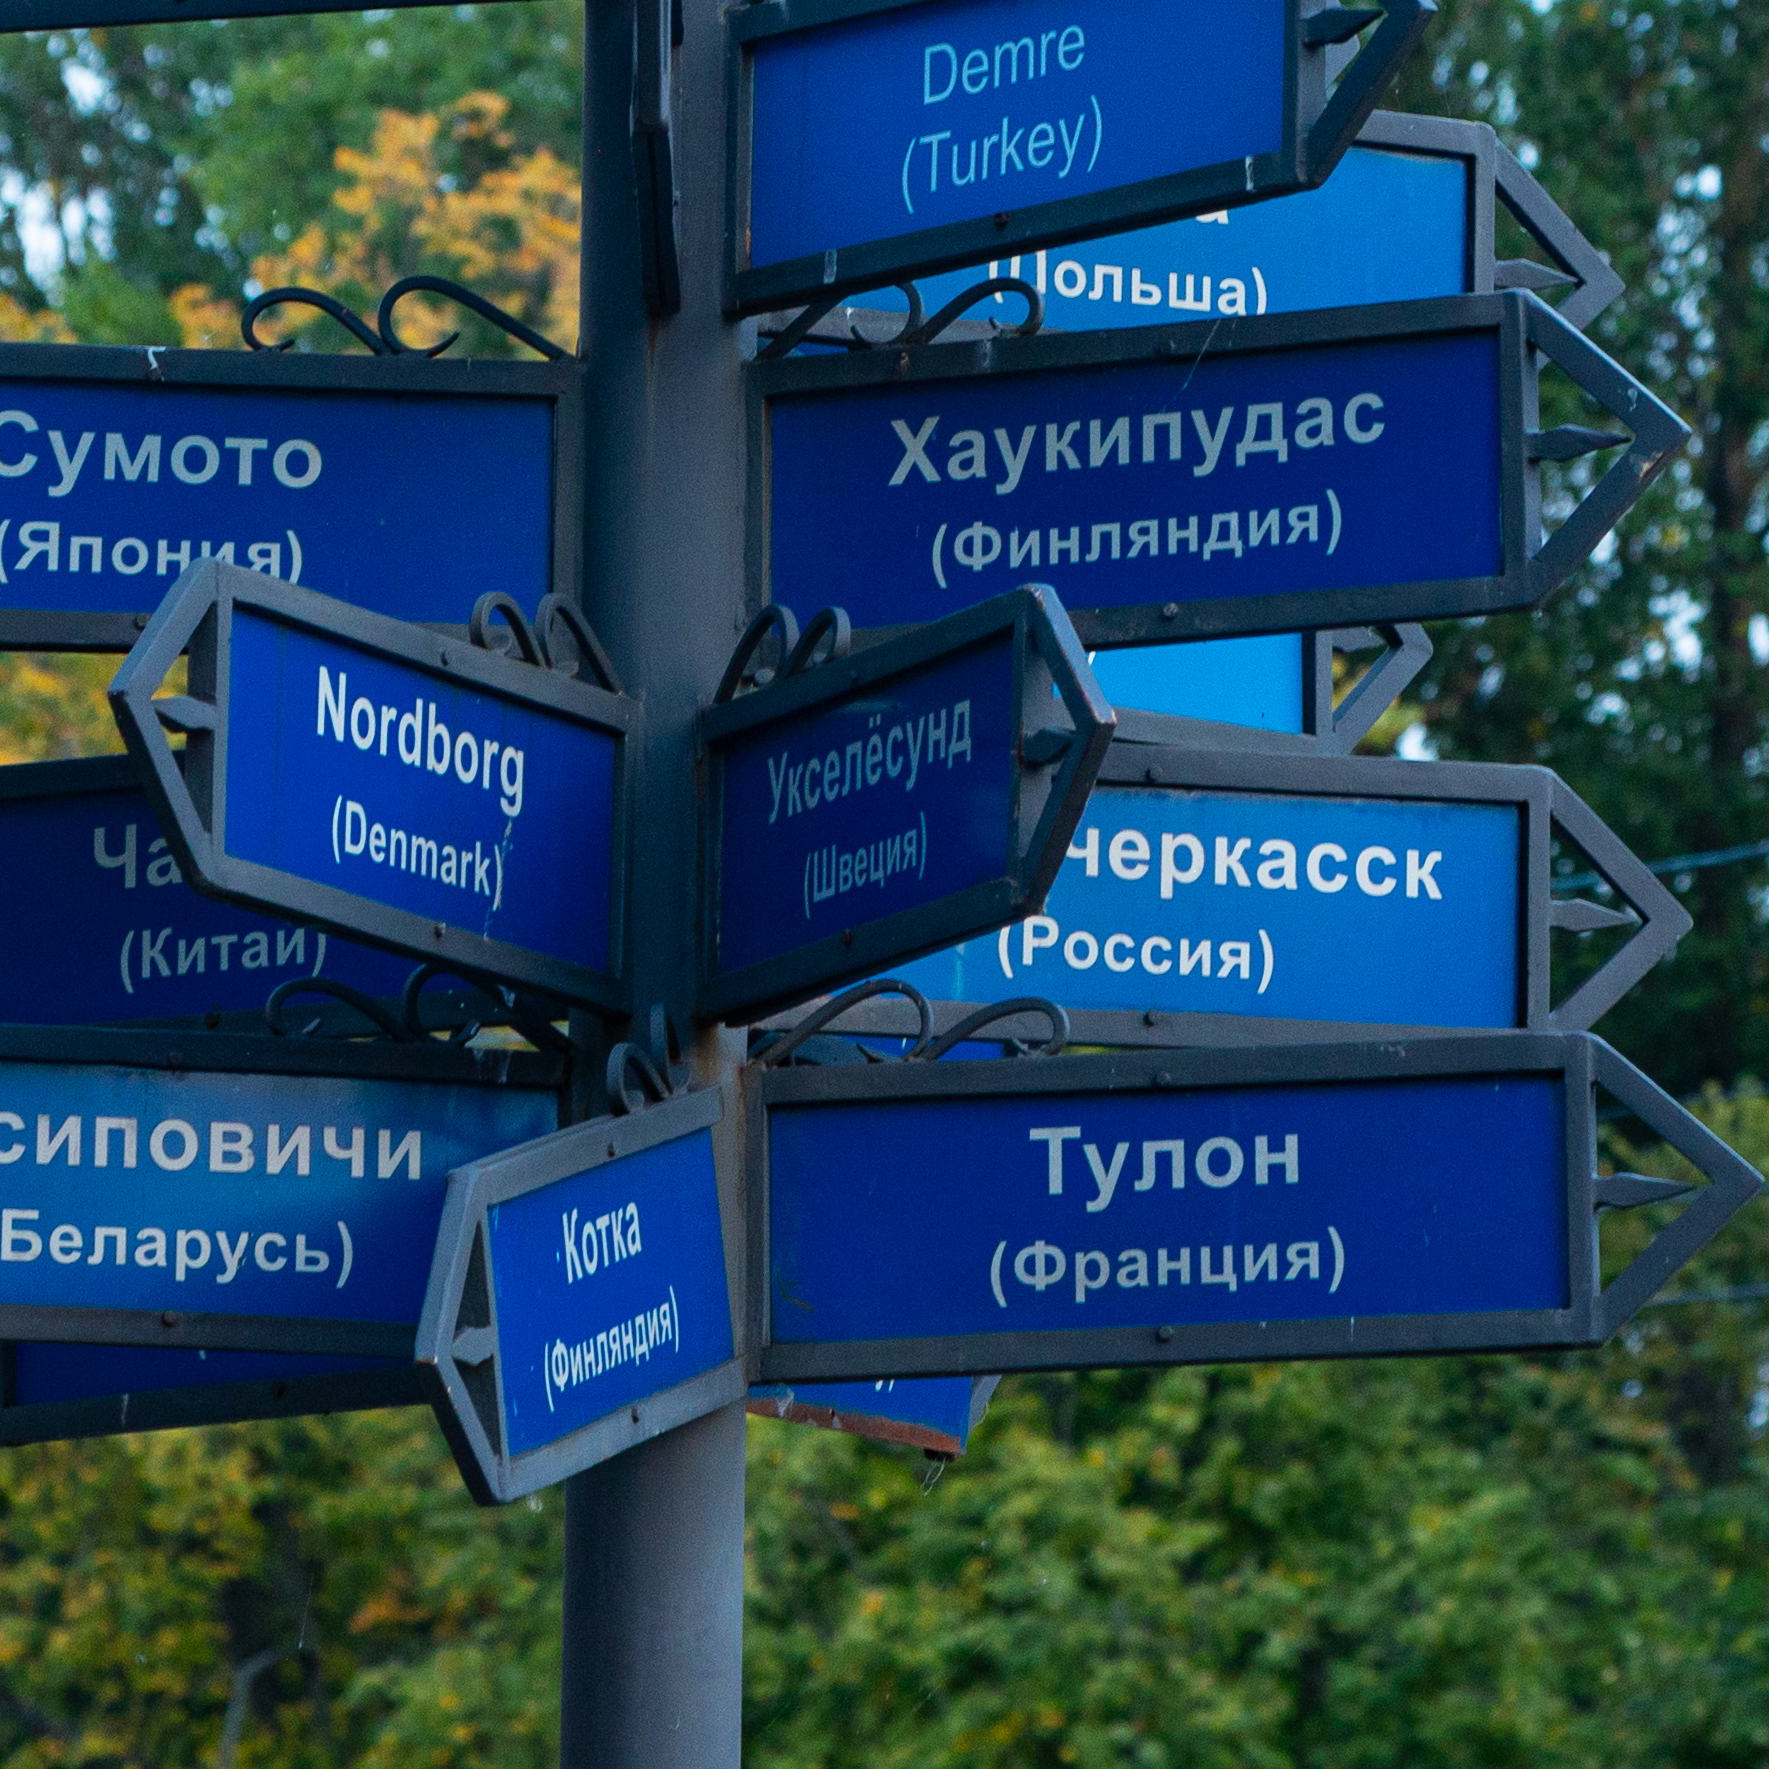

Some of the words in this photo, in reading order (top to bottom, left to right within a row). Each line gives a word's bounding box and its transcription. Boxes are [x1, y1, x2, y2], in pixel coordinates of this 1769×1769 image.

[924, 26, 1085, 105] Demre
[901, 98, 1103, 213] (Turkey)
[890, 393, 1385, 493] Хаукипудас
[932, 489, 1342, 593] (Финляндия)
[318, 666, 524, 816] Nordborg
[768, 699, 972, 824] Укселёсунд
[332, 795, 504, 910] (Denmark)
[803, 811, 927, 920] (Швеция)
[1067, 828, 1443, 900] черкасск
[998, 915, 1274, 994] (Россия)
[1029, 1126, 1299, 1212] Тулон
[562, 1202, 642, 1284] Котка
[990, 1226, 1345, 1308] (Франция)
[543, 1285, 679, 1412] (Финляндия)
